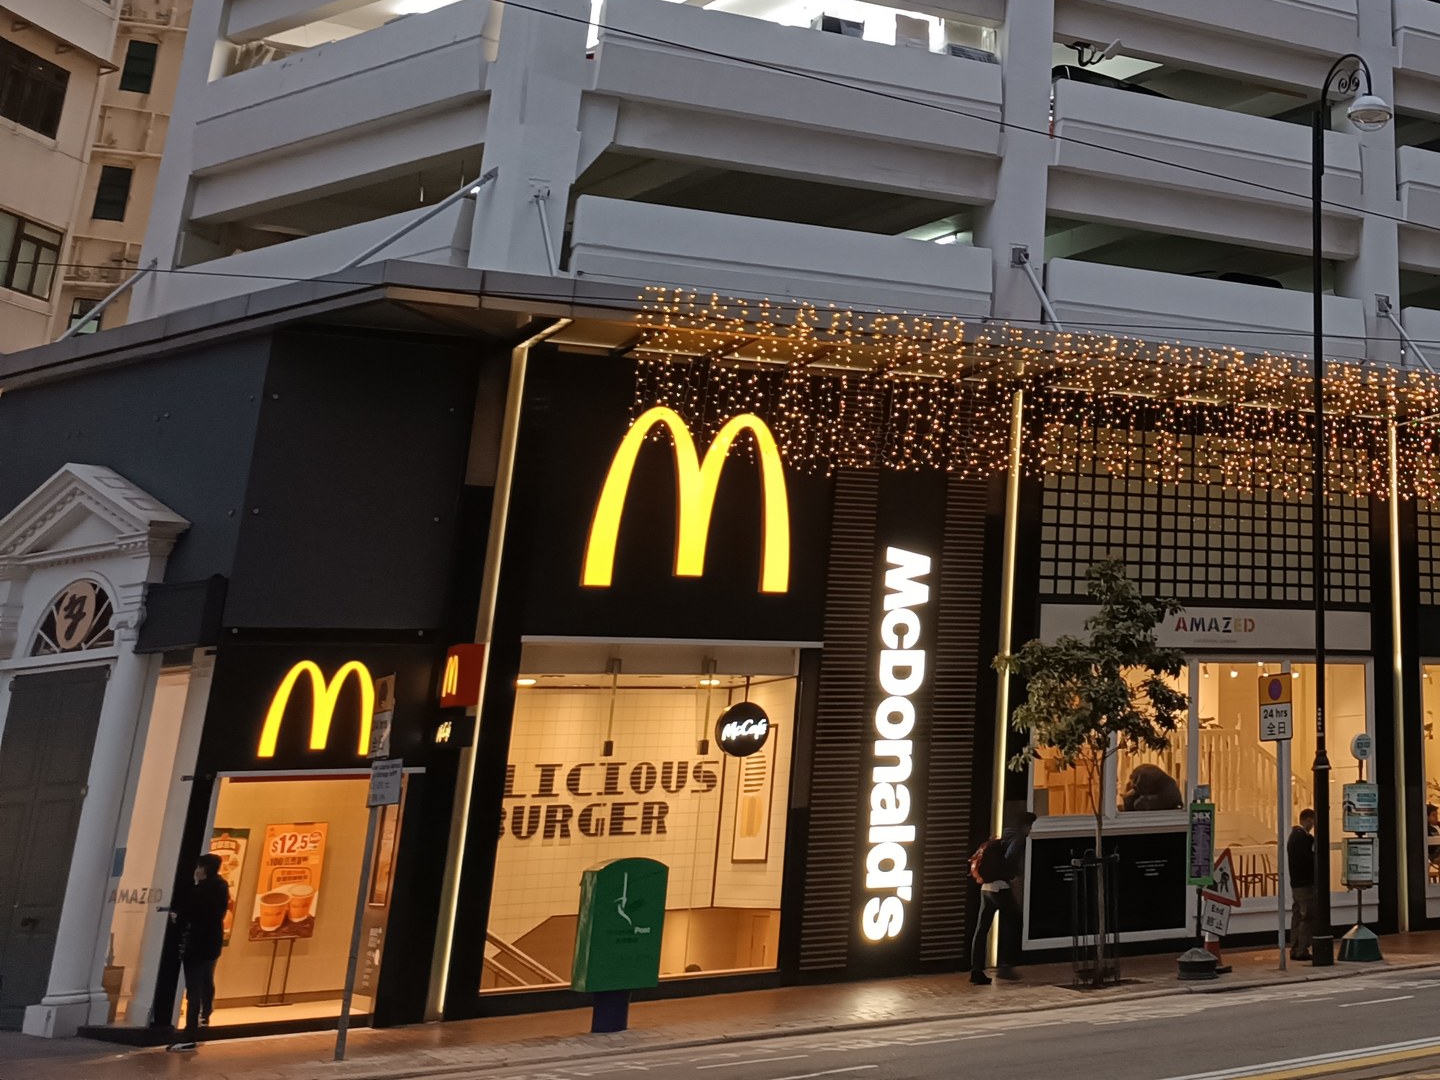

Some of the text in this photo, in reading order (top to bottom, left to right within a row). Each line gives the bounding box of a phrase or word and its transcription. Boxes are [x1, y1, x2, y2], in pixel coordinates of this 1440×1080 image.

[1174, 617, 1256, 634] AMAZED
[1263, 708, 1288, 719] 24 hrs
[1267, 721, 1286, 736] 全日
[862, 545, 932, 942] McDonald's
[108, 887, 163, 905] AMAZED
